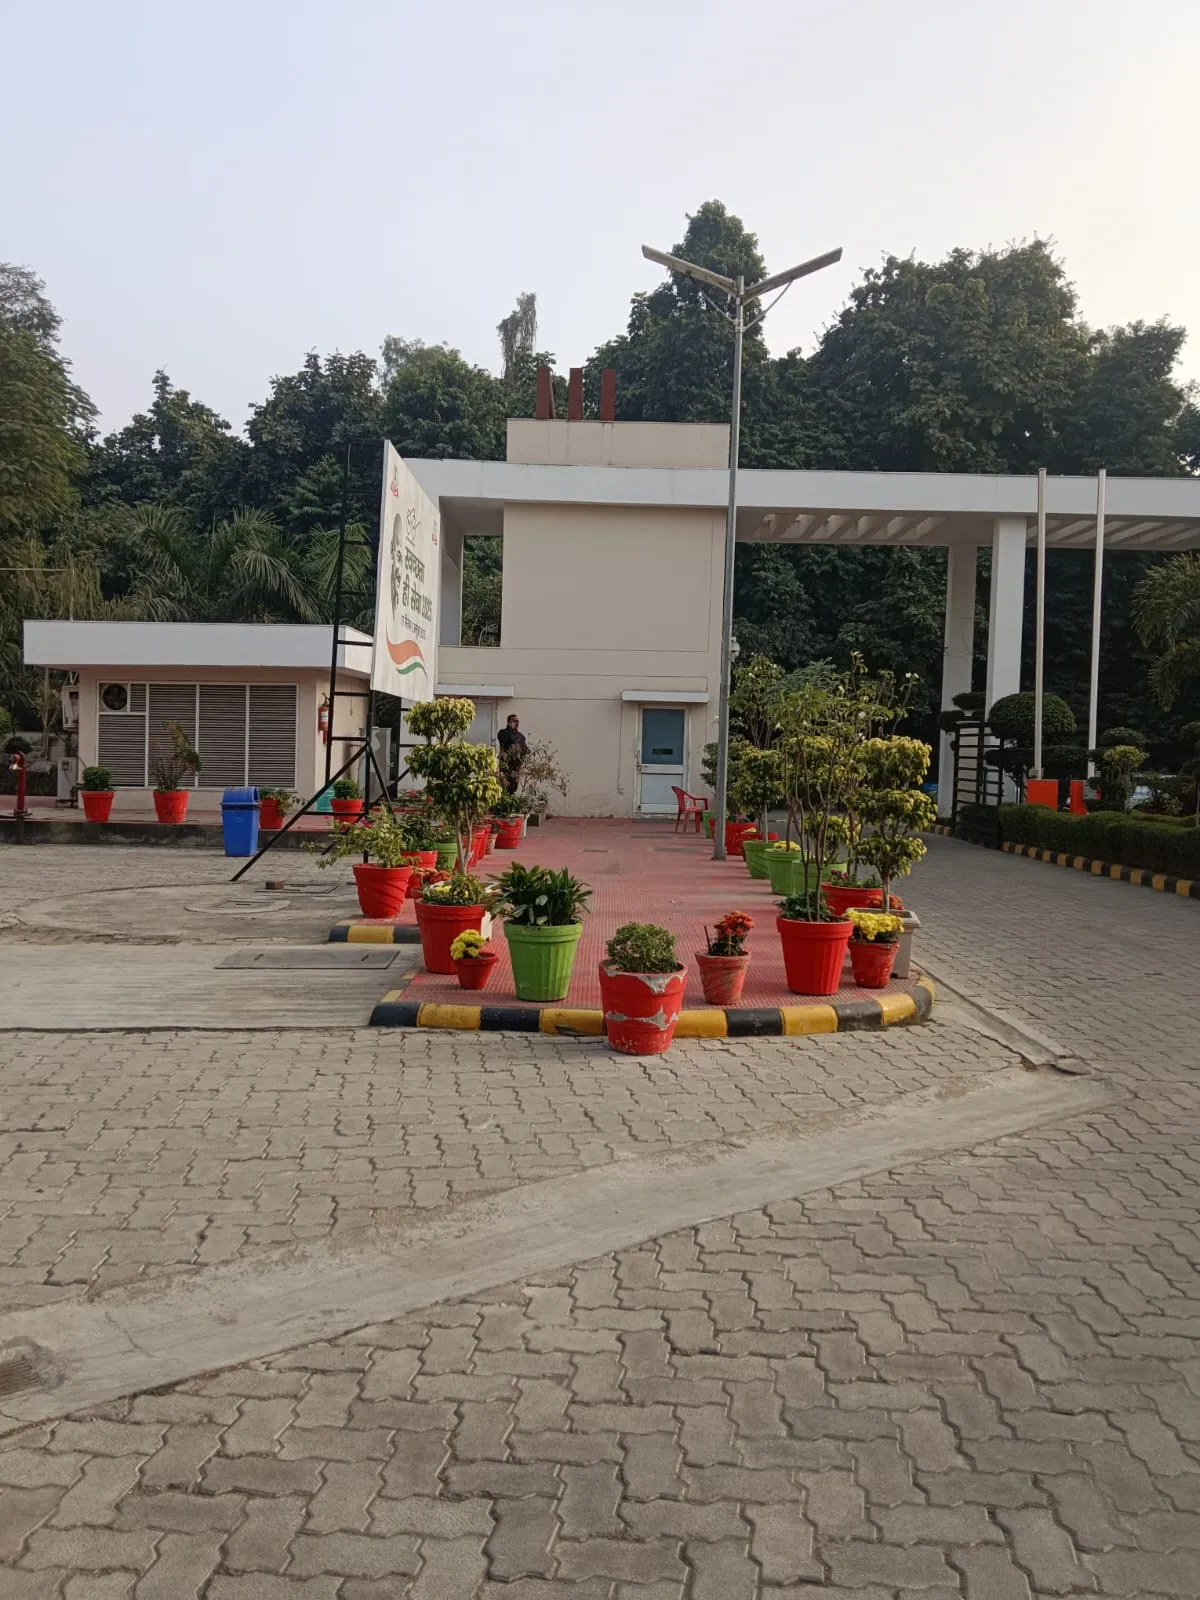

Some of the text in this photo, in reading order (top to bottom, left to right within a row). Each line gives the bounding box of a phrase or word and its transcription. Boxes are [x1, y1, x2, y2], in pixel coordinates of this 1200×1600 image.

[405, 546, 425, 584] स्वच्छता
[403, 574, 409, 607] ही
[411, 580, 421, 613] सेवा
